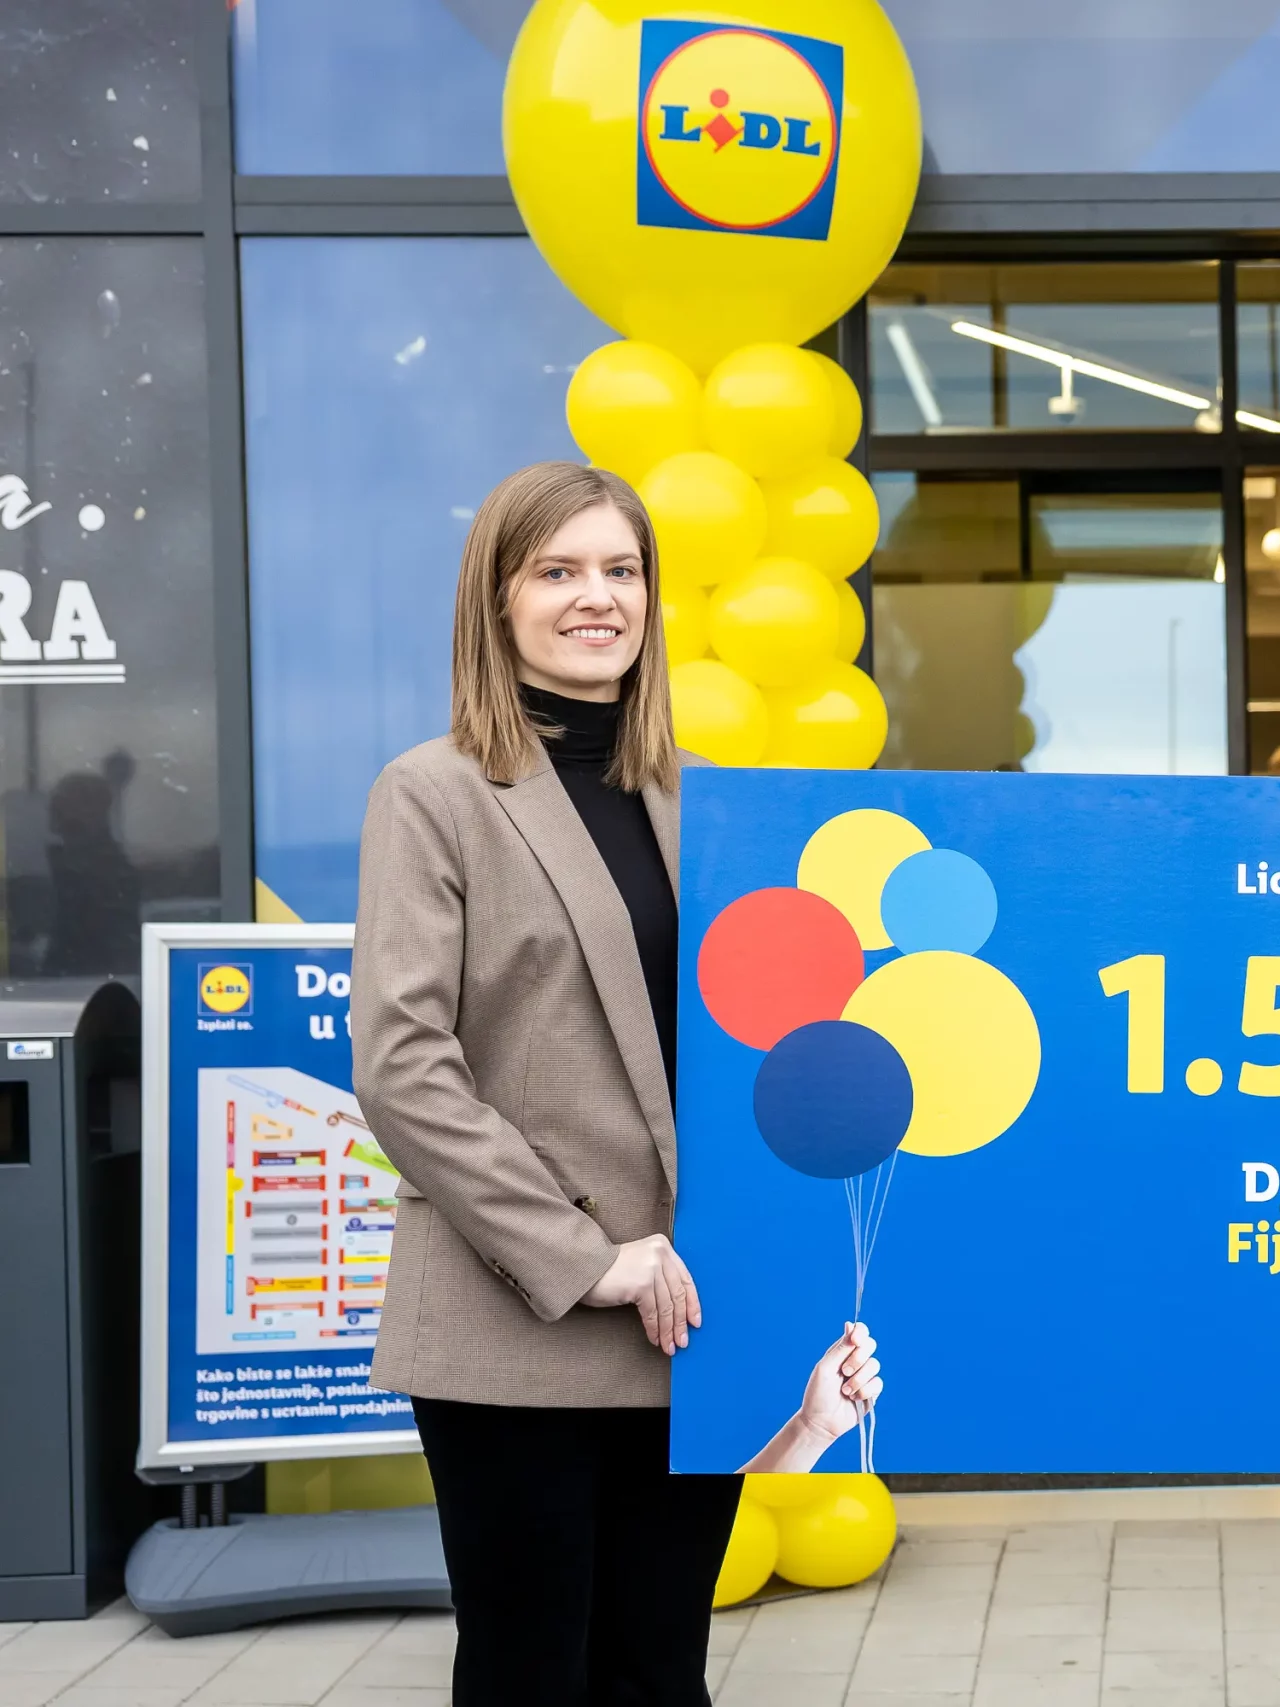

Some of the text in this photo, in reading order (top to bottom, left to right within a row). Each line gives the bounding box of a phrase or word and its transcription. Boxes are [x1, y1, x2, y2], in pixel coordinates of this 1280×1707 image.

[309, 1014, 336, 1040] u
[196, 1370, 235, 1384] Kako
[236, 1367, 273, 1383] biste
[275, 1368, 292, 1380] se
[294, 1364, 333, 1379] lakše
[221, 1384, 325, 1404] jednostavnije,
[195, 1405, 260, 1424] trgovine
[261, 1408, 270, 1420] s
[272, 1402, 338, 1419] ucrtanim
